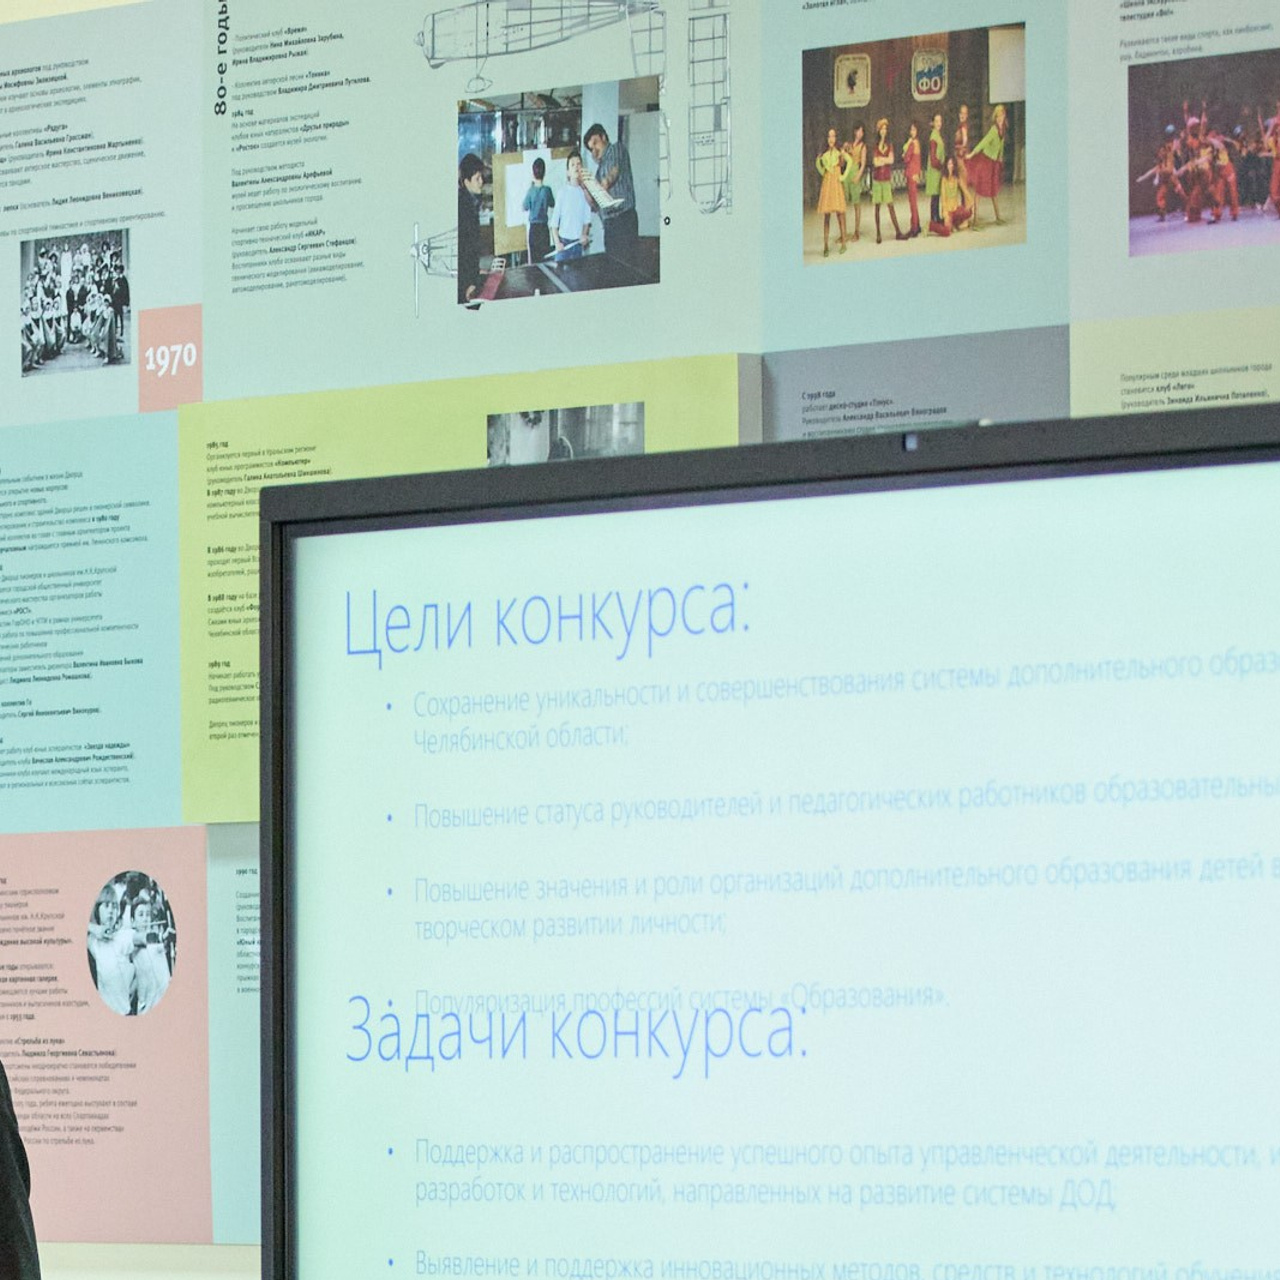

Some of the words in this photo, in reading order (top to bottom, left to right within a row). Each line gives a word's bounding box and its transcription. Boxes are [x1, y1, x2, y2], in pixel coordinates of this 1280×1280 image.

[144, 342, 198, 378] 1970
[345, 588, 474, 671] Цели
[496, 581, 751, 661] конкурса:
[414, 688, 530, 721] Сохранение
[536, 682, 671, 716] уникальности
[677, 683, 690, 701] и
[696, 669, 906, 706] совершенствования
[912, 665, 1000, 691] системы
[1006, 652, 1202, 690] дополнительного
[414, 720, 540, 755] Челябинской
[546, 720, 630, 748] области;
[414, 802, 529, 830] Повышение
[535, 799, 605, 831] статуса
[610, 790, 763, 829] руководителей
[769, 794, 782, 813] и
[788, 787, 951, 817] педагогических
[959, 779, 1086, 815] работников
[414, 876, 530, 904] Повышение
[536, 874, 628, 901] значения
[635, 876, 648, 895] и
[653, 869, 703, 902] роли
[709, 862, 844, 902] организаций
[850, 861, 1038, 894] дополнительного
[1046, 855, 1192, 890] образования
[1199, 851, 1264, 884] детей
[414, 917, 526, 947] творческом
[533, 913, 623, 944] развитии
[629, 910, 728, 936] личности;
[345, 994, 529, 1075] Задачи
[551, 1002, 808, 1080] конкурса:
[415, 1138, 524, 1168] Поддержка
[531, 1145, 542, 1164] и
[549, 1141, 724, 1172] распространение
[731, 1143, 843, 1172] успешного
[849, 1142, 914, 1166] опыта
[919, 1139, 1098, 1172] управленческой
[1104, 1142, 1262, 1170] деятельности,
[415, 1175, 526, 1208] разработок
[532, 1183, 543, 1202] и
[550, 1177, 667, 1205] технологий,
[673, 1182, 821, 1208] направленных
[827, 1185, 853, 1205] на
[859, 1182, 955, 1211] развитие
[962, 1184, 1053, 1207] системы
[415, 1249, 520, 1277] Выявление
[527, 1257, 538, 1277] и
